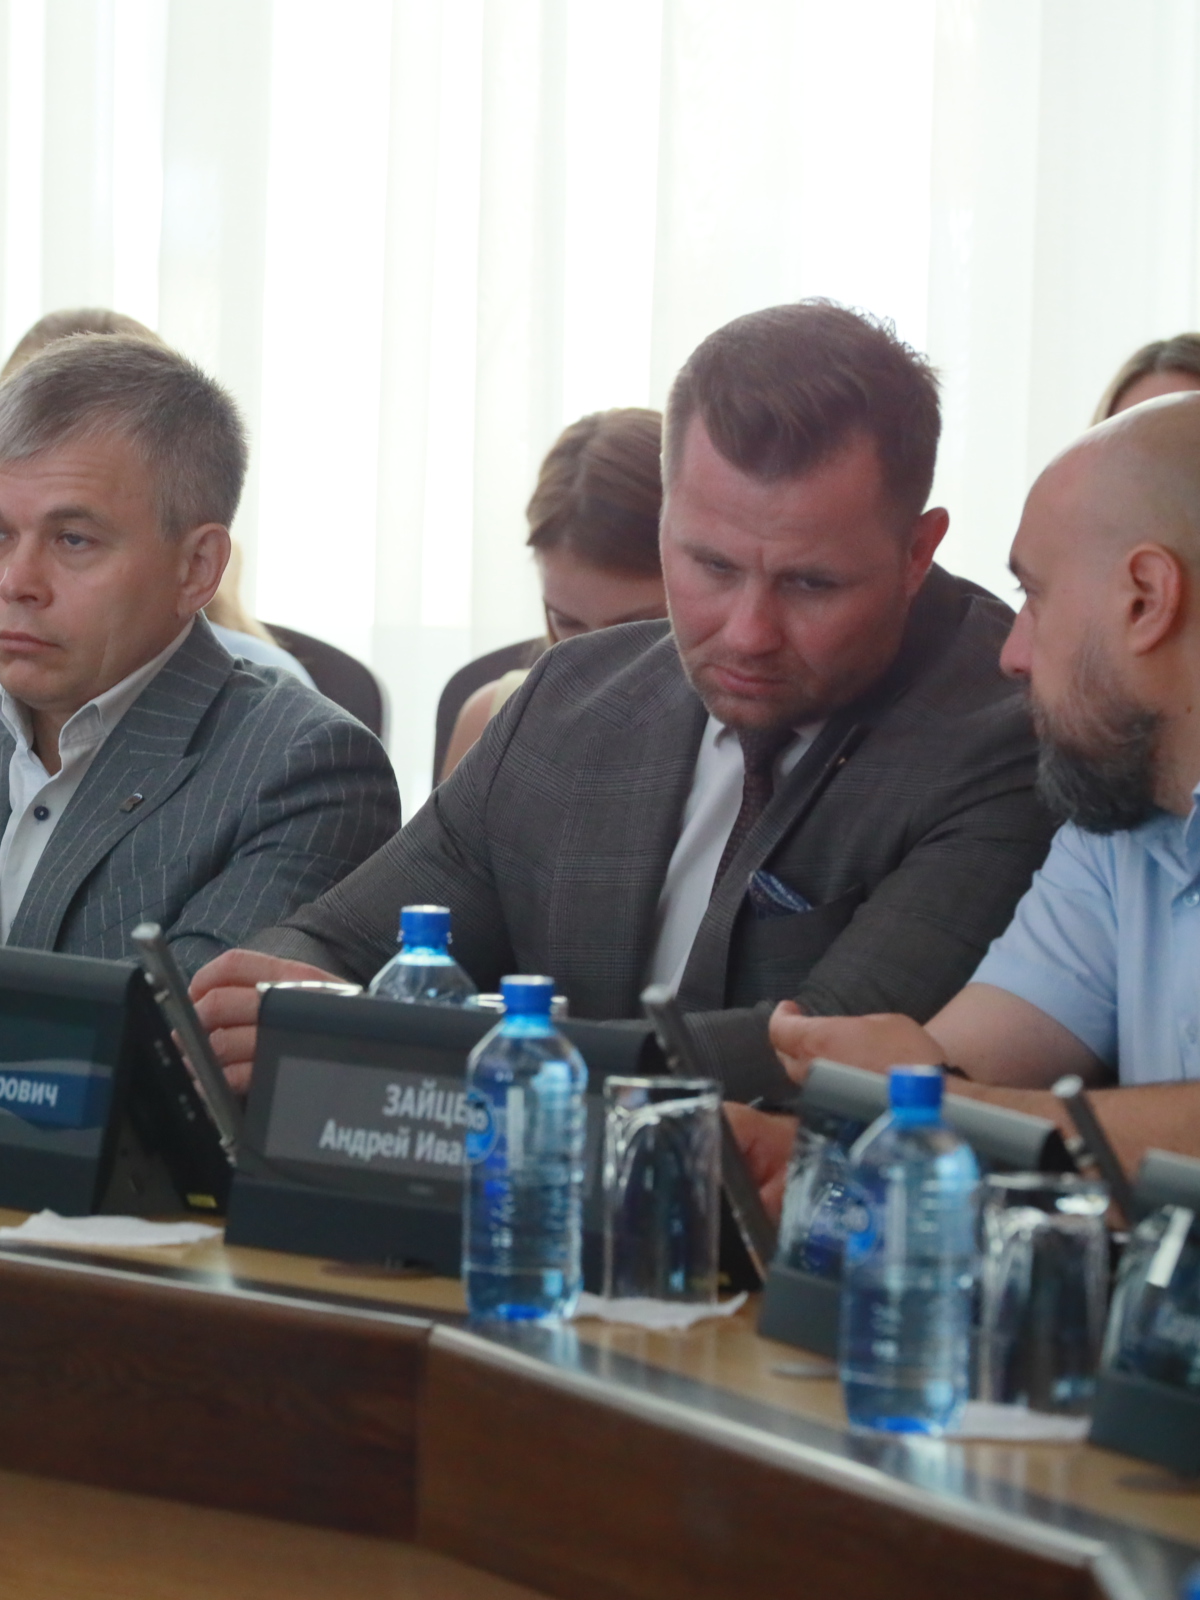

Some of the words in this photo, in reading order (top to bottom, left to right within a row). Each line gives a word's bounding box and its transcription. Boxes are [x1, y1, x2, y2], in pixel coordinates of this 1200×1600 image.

[381, 1078, 469, 1130] ЗАЙЦЕ
[318, 1118, 412, 1163] Андрей
[414, 1129, 464, 1167] Ива
